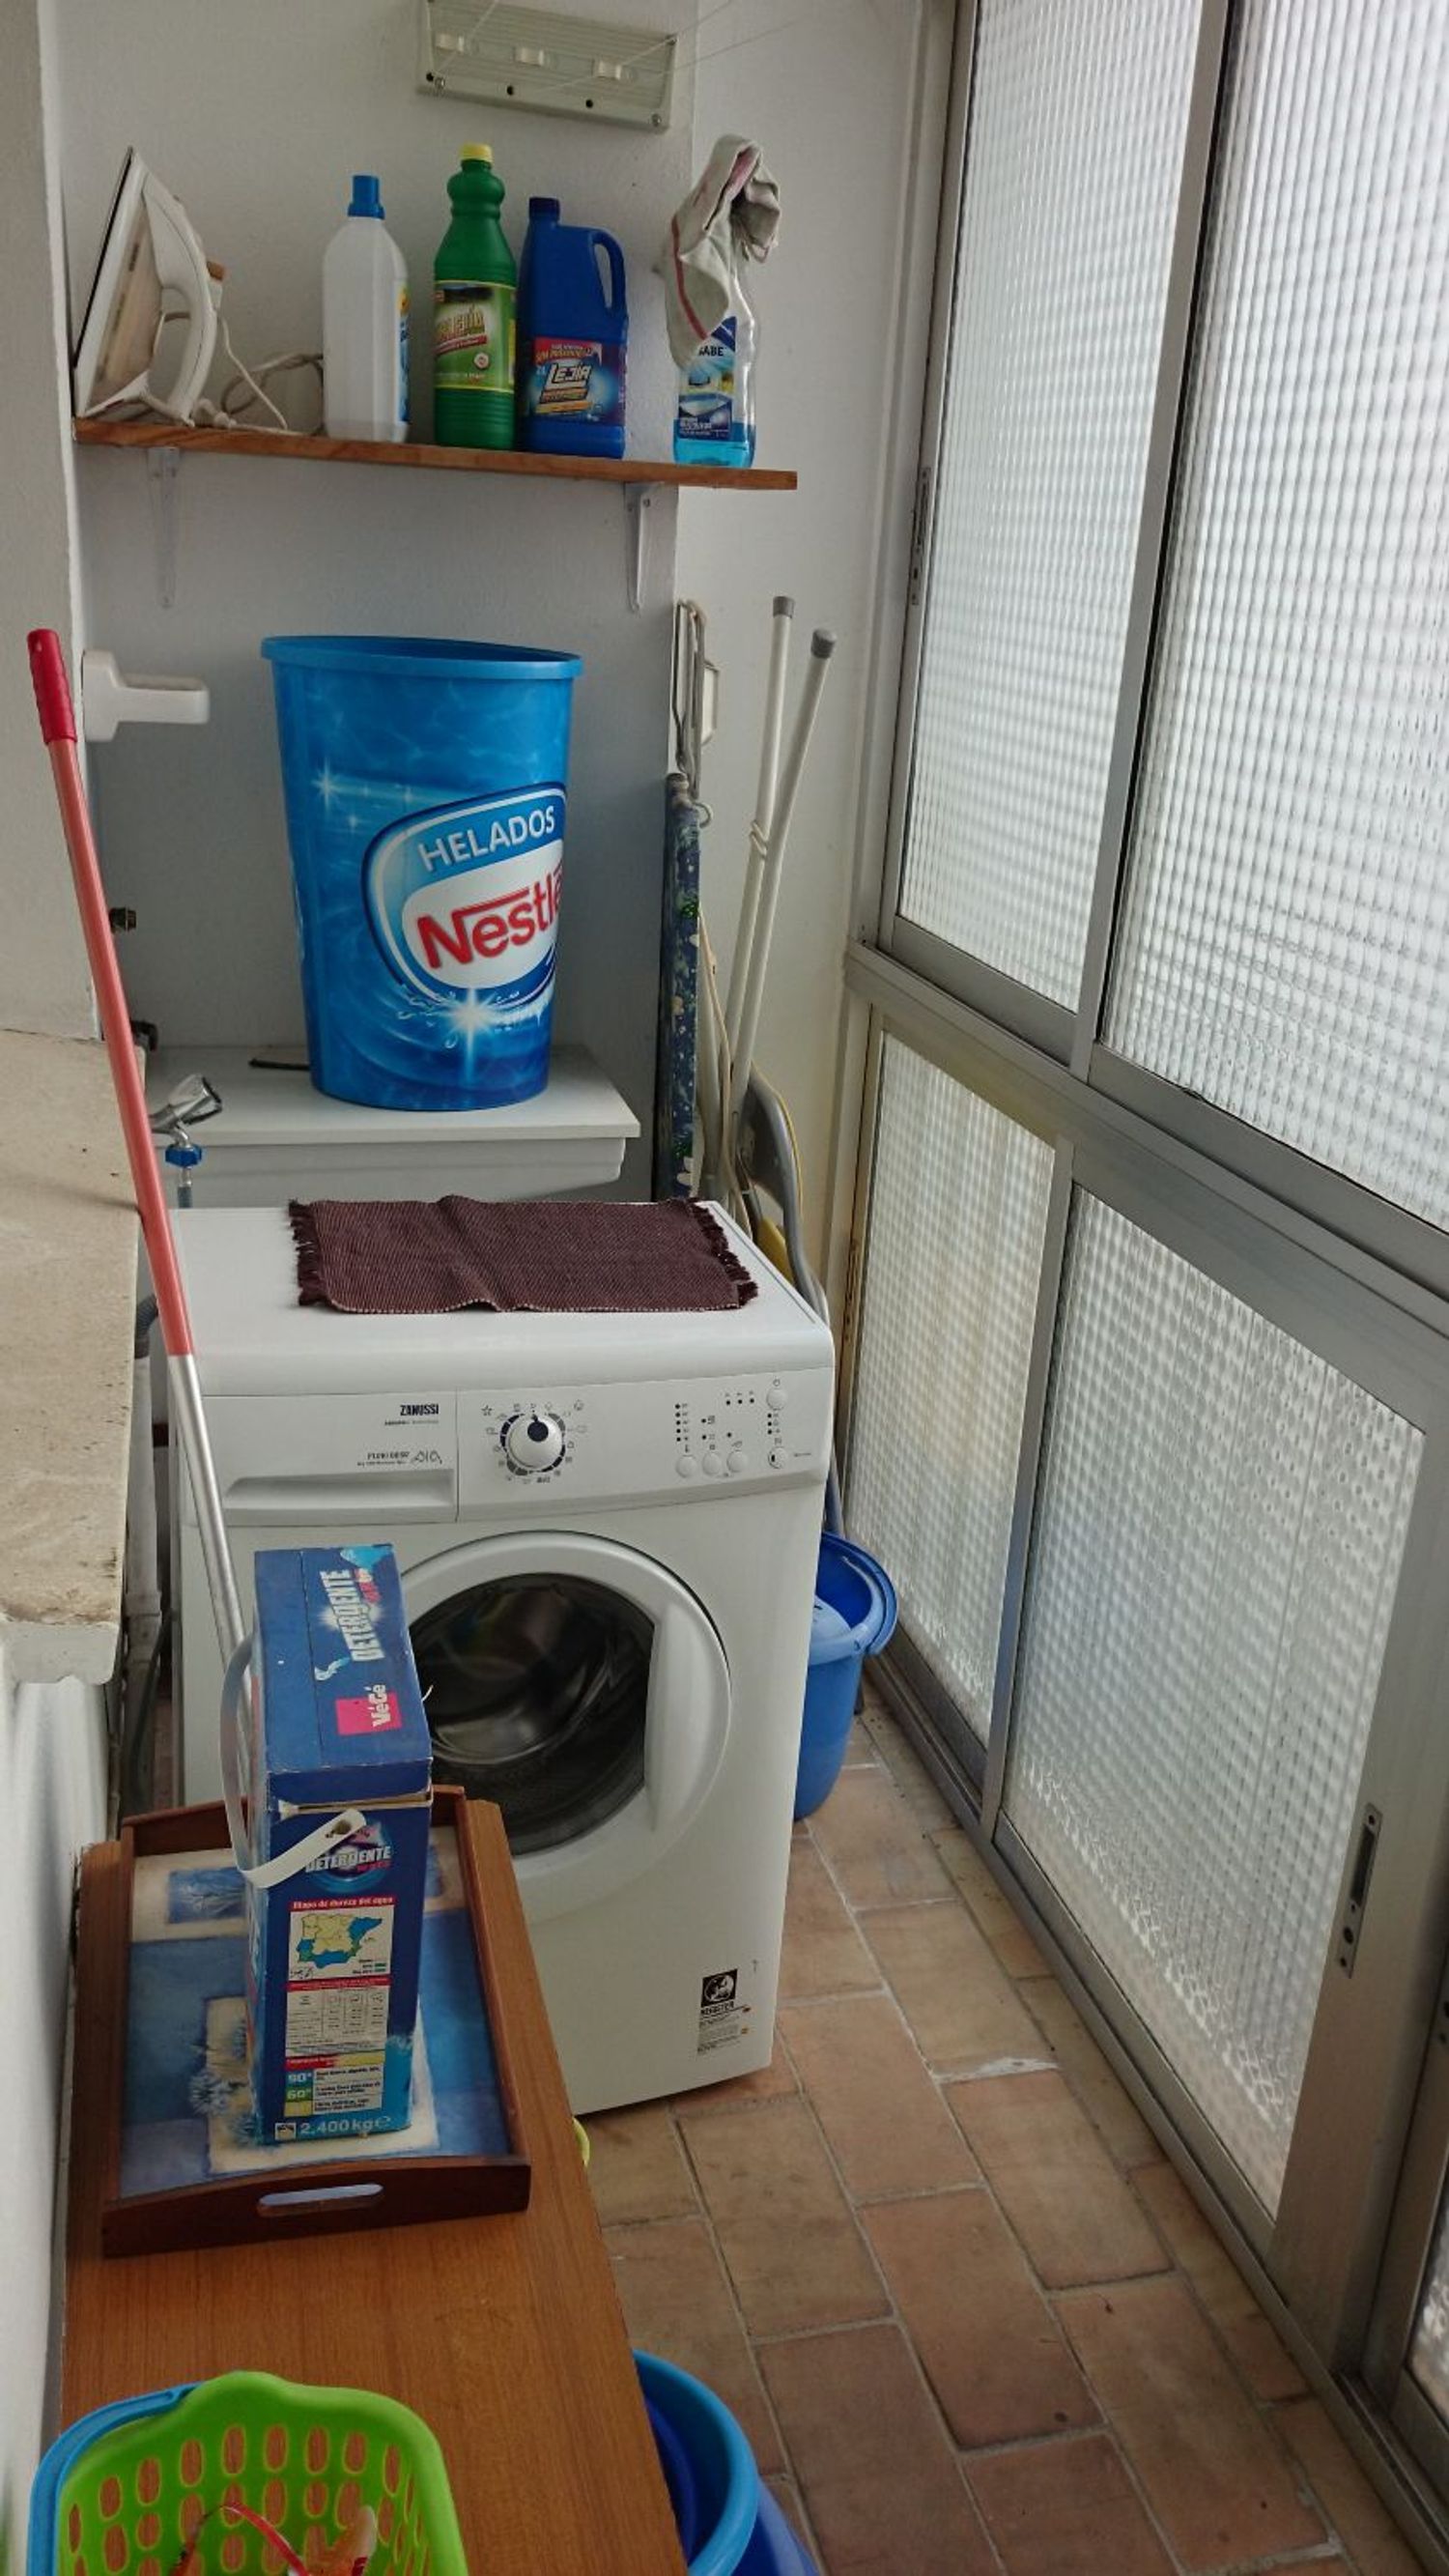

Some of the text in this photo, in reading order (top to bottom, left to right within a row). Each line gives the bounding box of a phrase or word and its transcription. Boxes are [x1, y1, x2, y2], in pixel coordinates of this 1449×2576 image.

[417, 806, 556, 872] HELADOS
[400, 1403, 440, 1417] ZANUSSI
[320, 1569, 385, 1661] DETERGENTE
[305, 1846, 391, 1873] DETERGENTE
